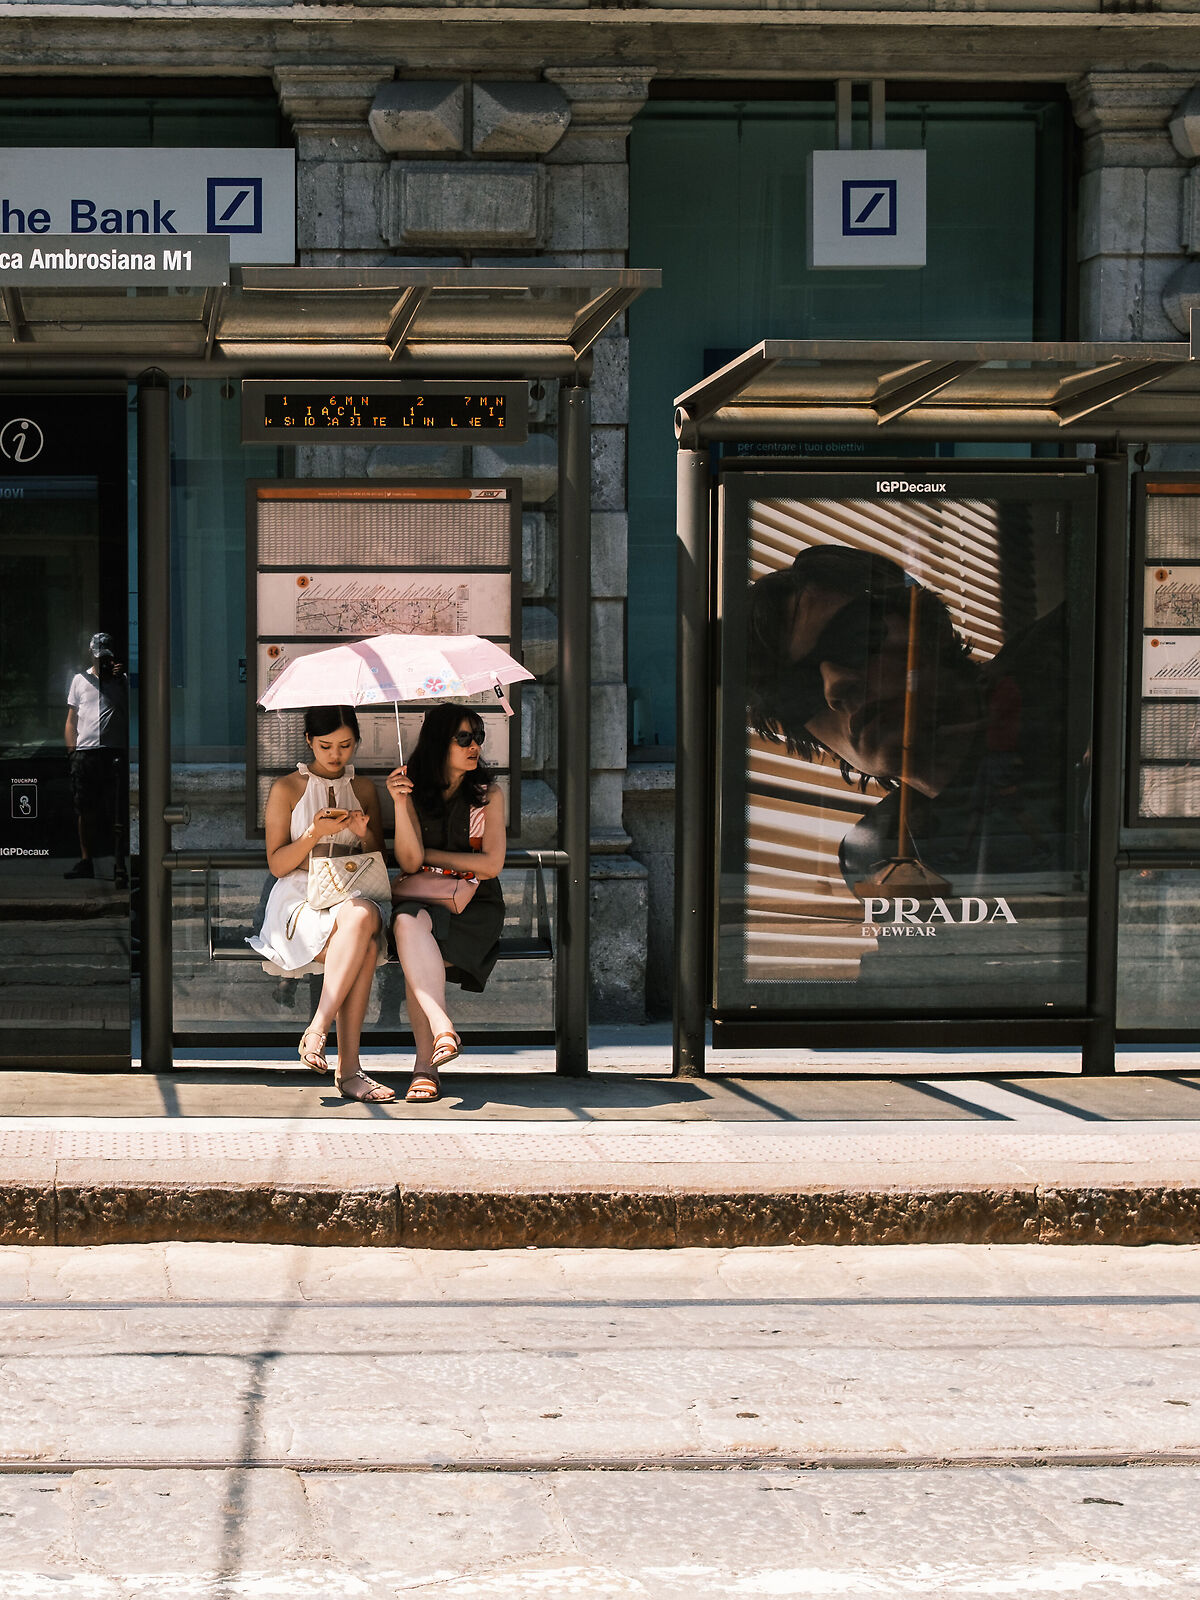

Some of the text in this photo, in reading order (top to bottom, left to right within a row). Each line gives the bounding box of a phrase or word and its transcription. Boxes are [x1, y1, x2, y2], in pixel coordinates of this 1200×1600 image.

[70, 198, 178, 233] Bank
[29, 248, 156, 271] Ambrosiana
[163, 250, 193, 271] M1
[737, 442, 753, 453] per
[756, 442, 796, 452] centrare
[804, 442, 824, 452] tuoi
[826, 442, 865, 452] obiettivi
[876, 481, 947, 493] IGPDecaux
[0, 847, 50, 856] IGPDecaux
[861, 897, 1019, 924] PRADA
[861, 926, 937, 937] EYEWEAR
